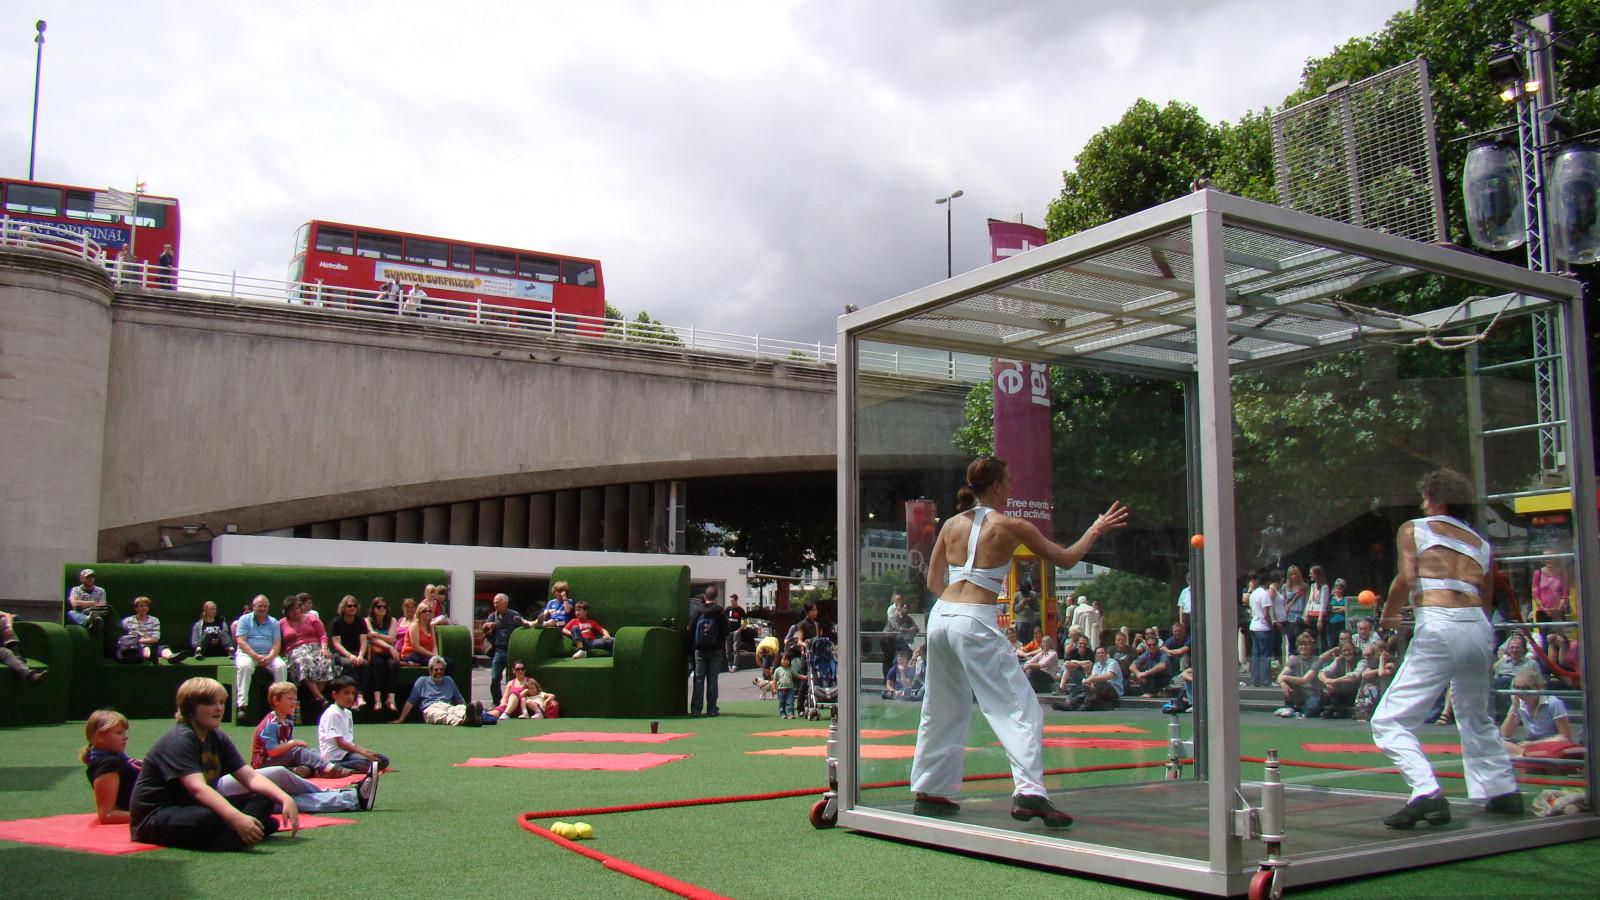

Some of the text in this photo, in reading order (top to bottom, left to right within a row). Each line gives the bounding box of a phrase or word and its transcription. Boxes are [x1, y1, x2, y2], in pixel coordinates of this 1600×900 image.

[383, 269, 425, 283] SUMMER
[1007, 498, 1027, 507] Free
[1004, 509, 1021, 518] and
